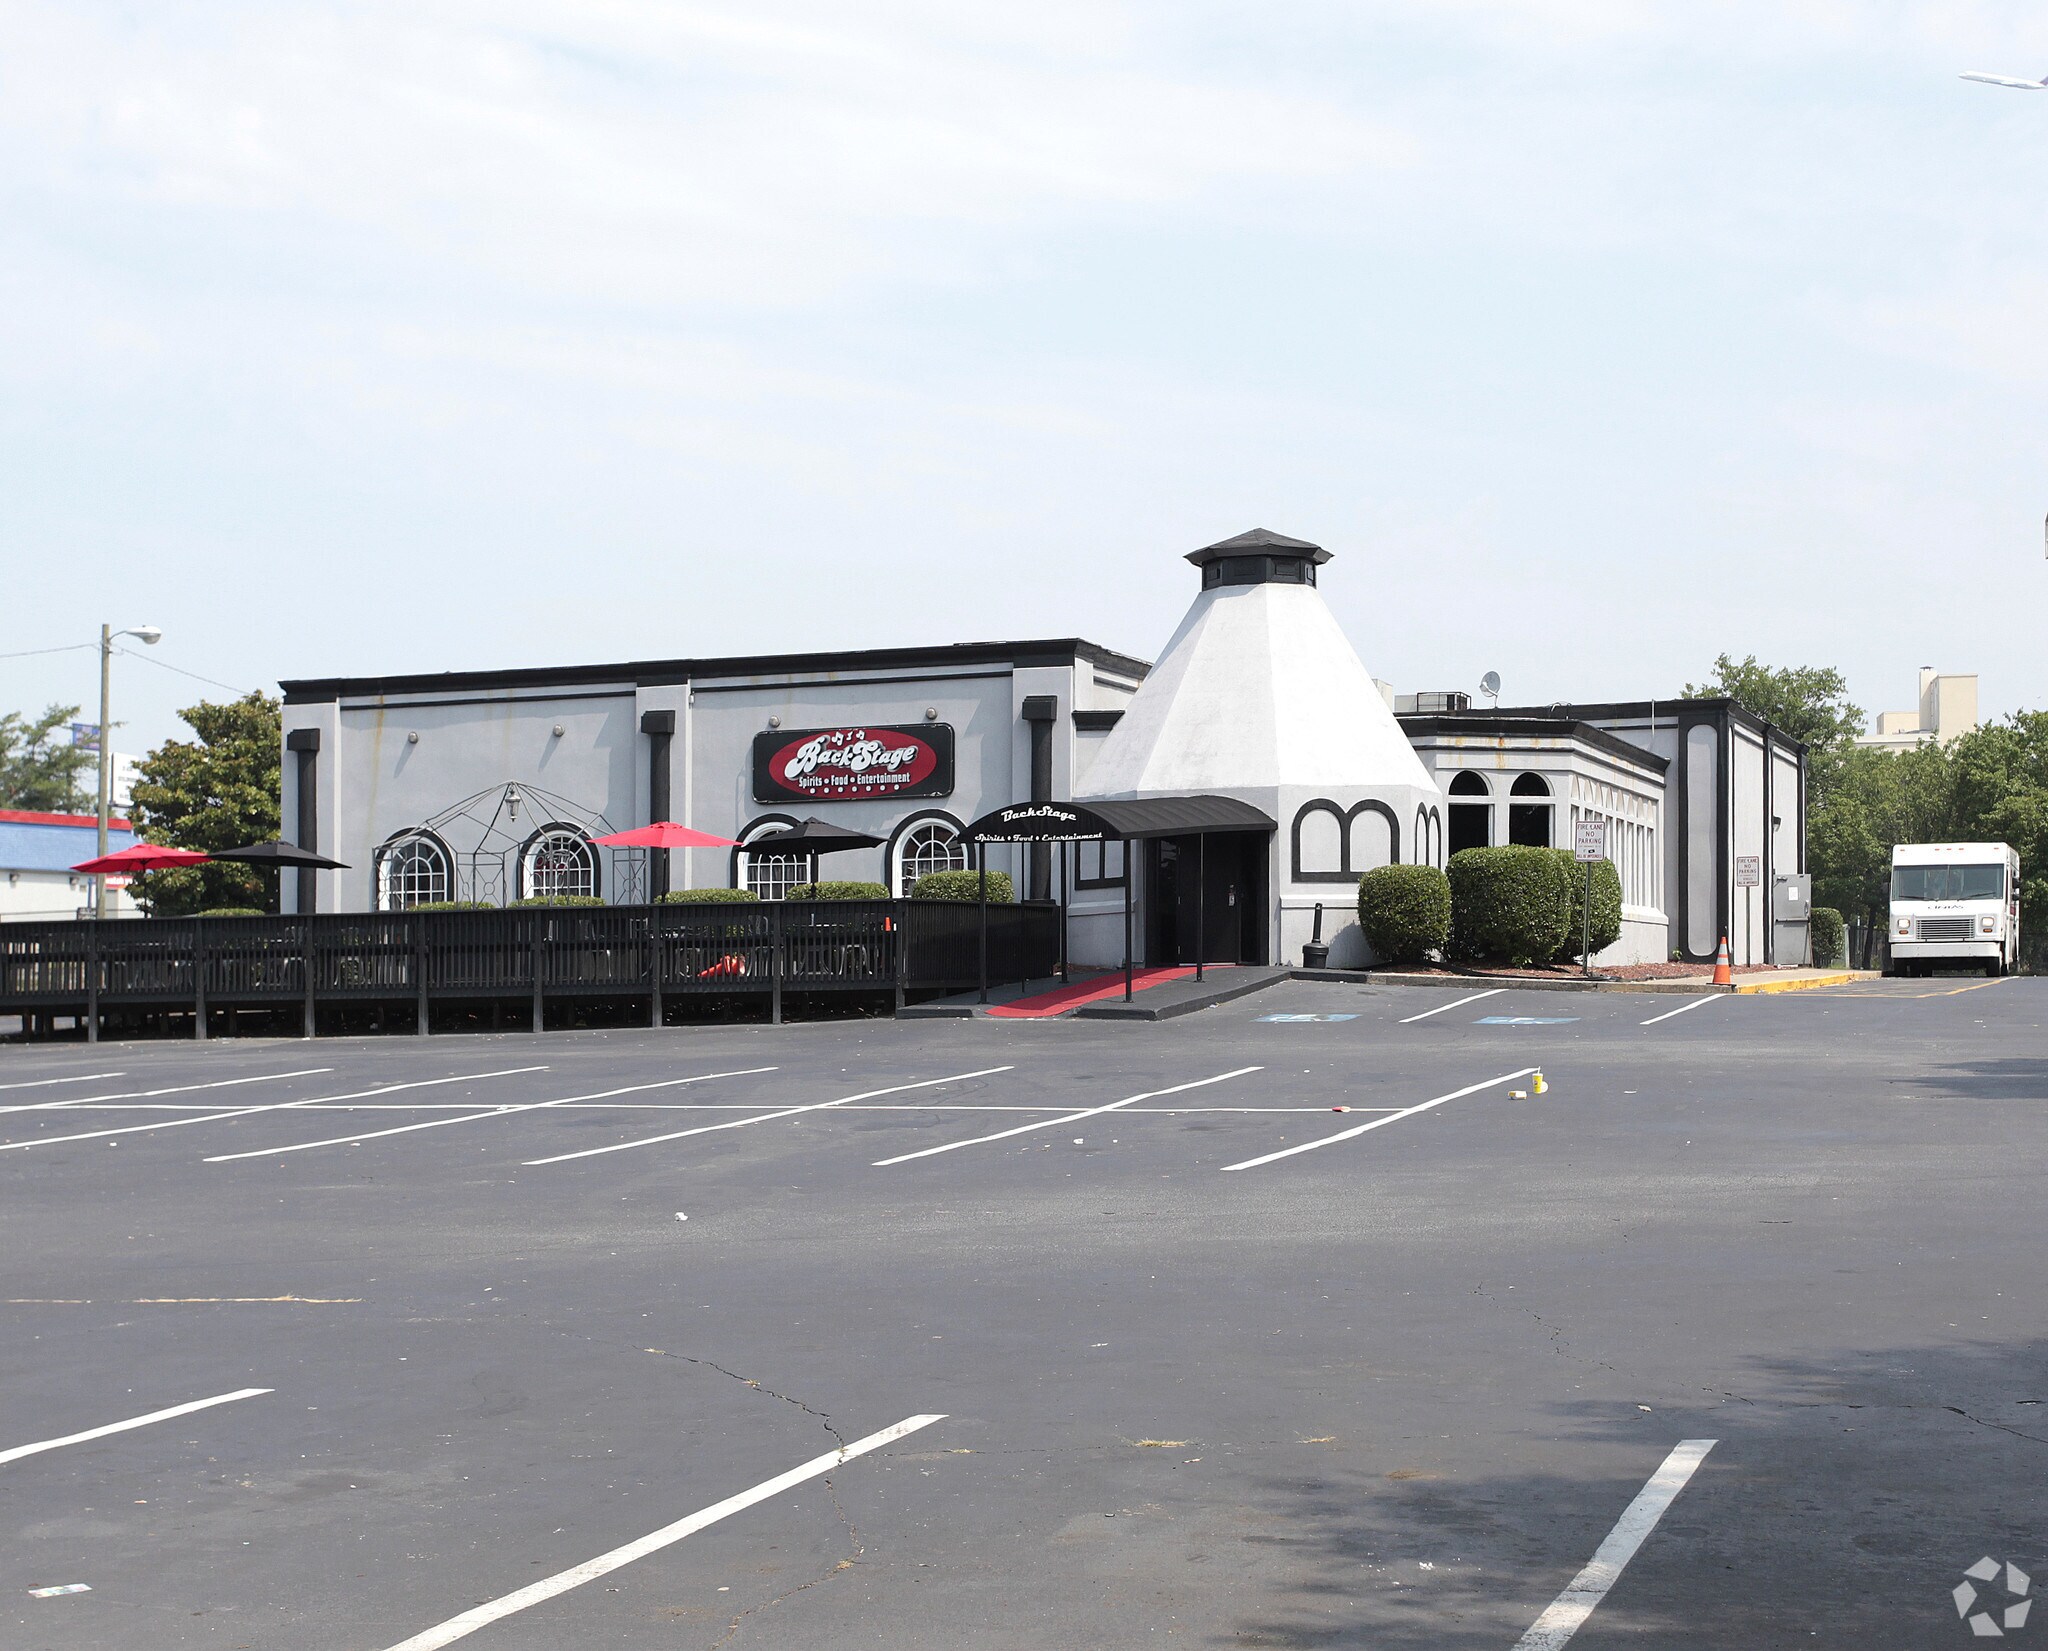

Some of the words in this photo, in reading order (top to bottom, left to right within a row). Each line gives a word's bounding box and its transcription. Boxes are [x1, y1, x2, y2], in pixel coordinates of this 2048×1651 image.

[784, 735, 917, 779] BackStage
[799, 775, 823, 789] Spirits
[831, 774, 849, 786] Food
[857, 772, 910, 785] Entertainment
[1001, 805, 1077, 822] BackStage
[975, 833, 1005, 842] Spirits
[1012, 834, 1034, 842] Food
[1041, 831, 1103, 842] Entertainment
